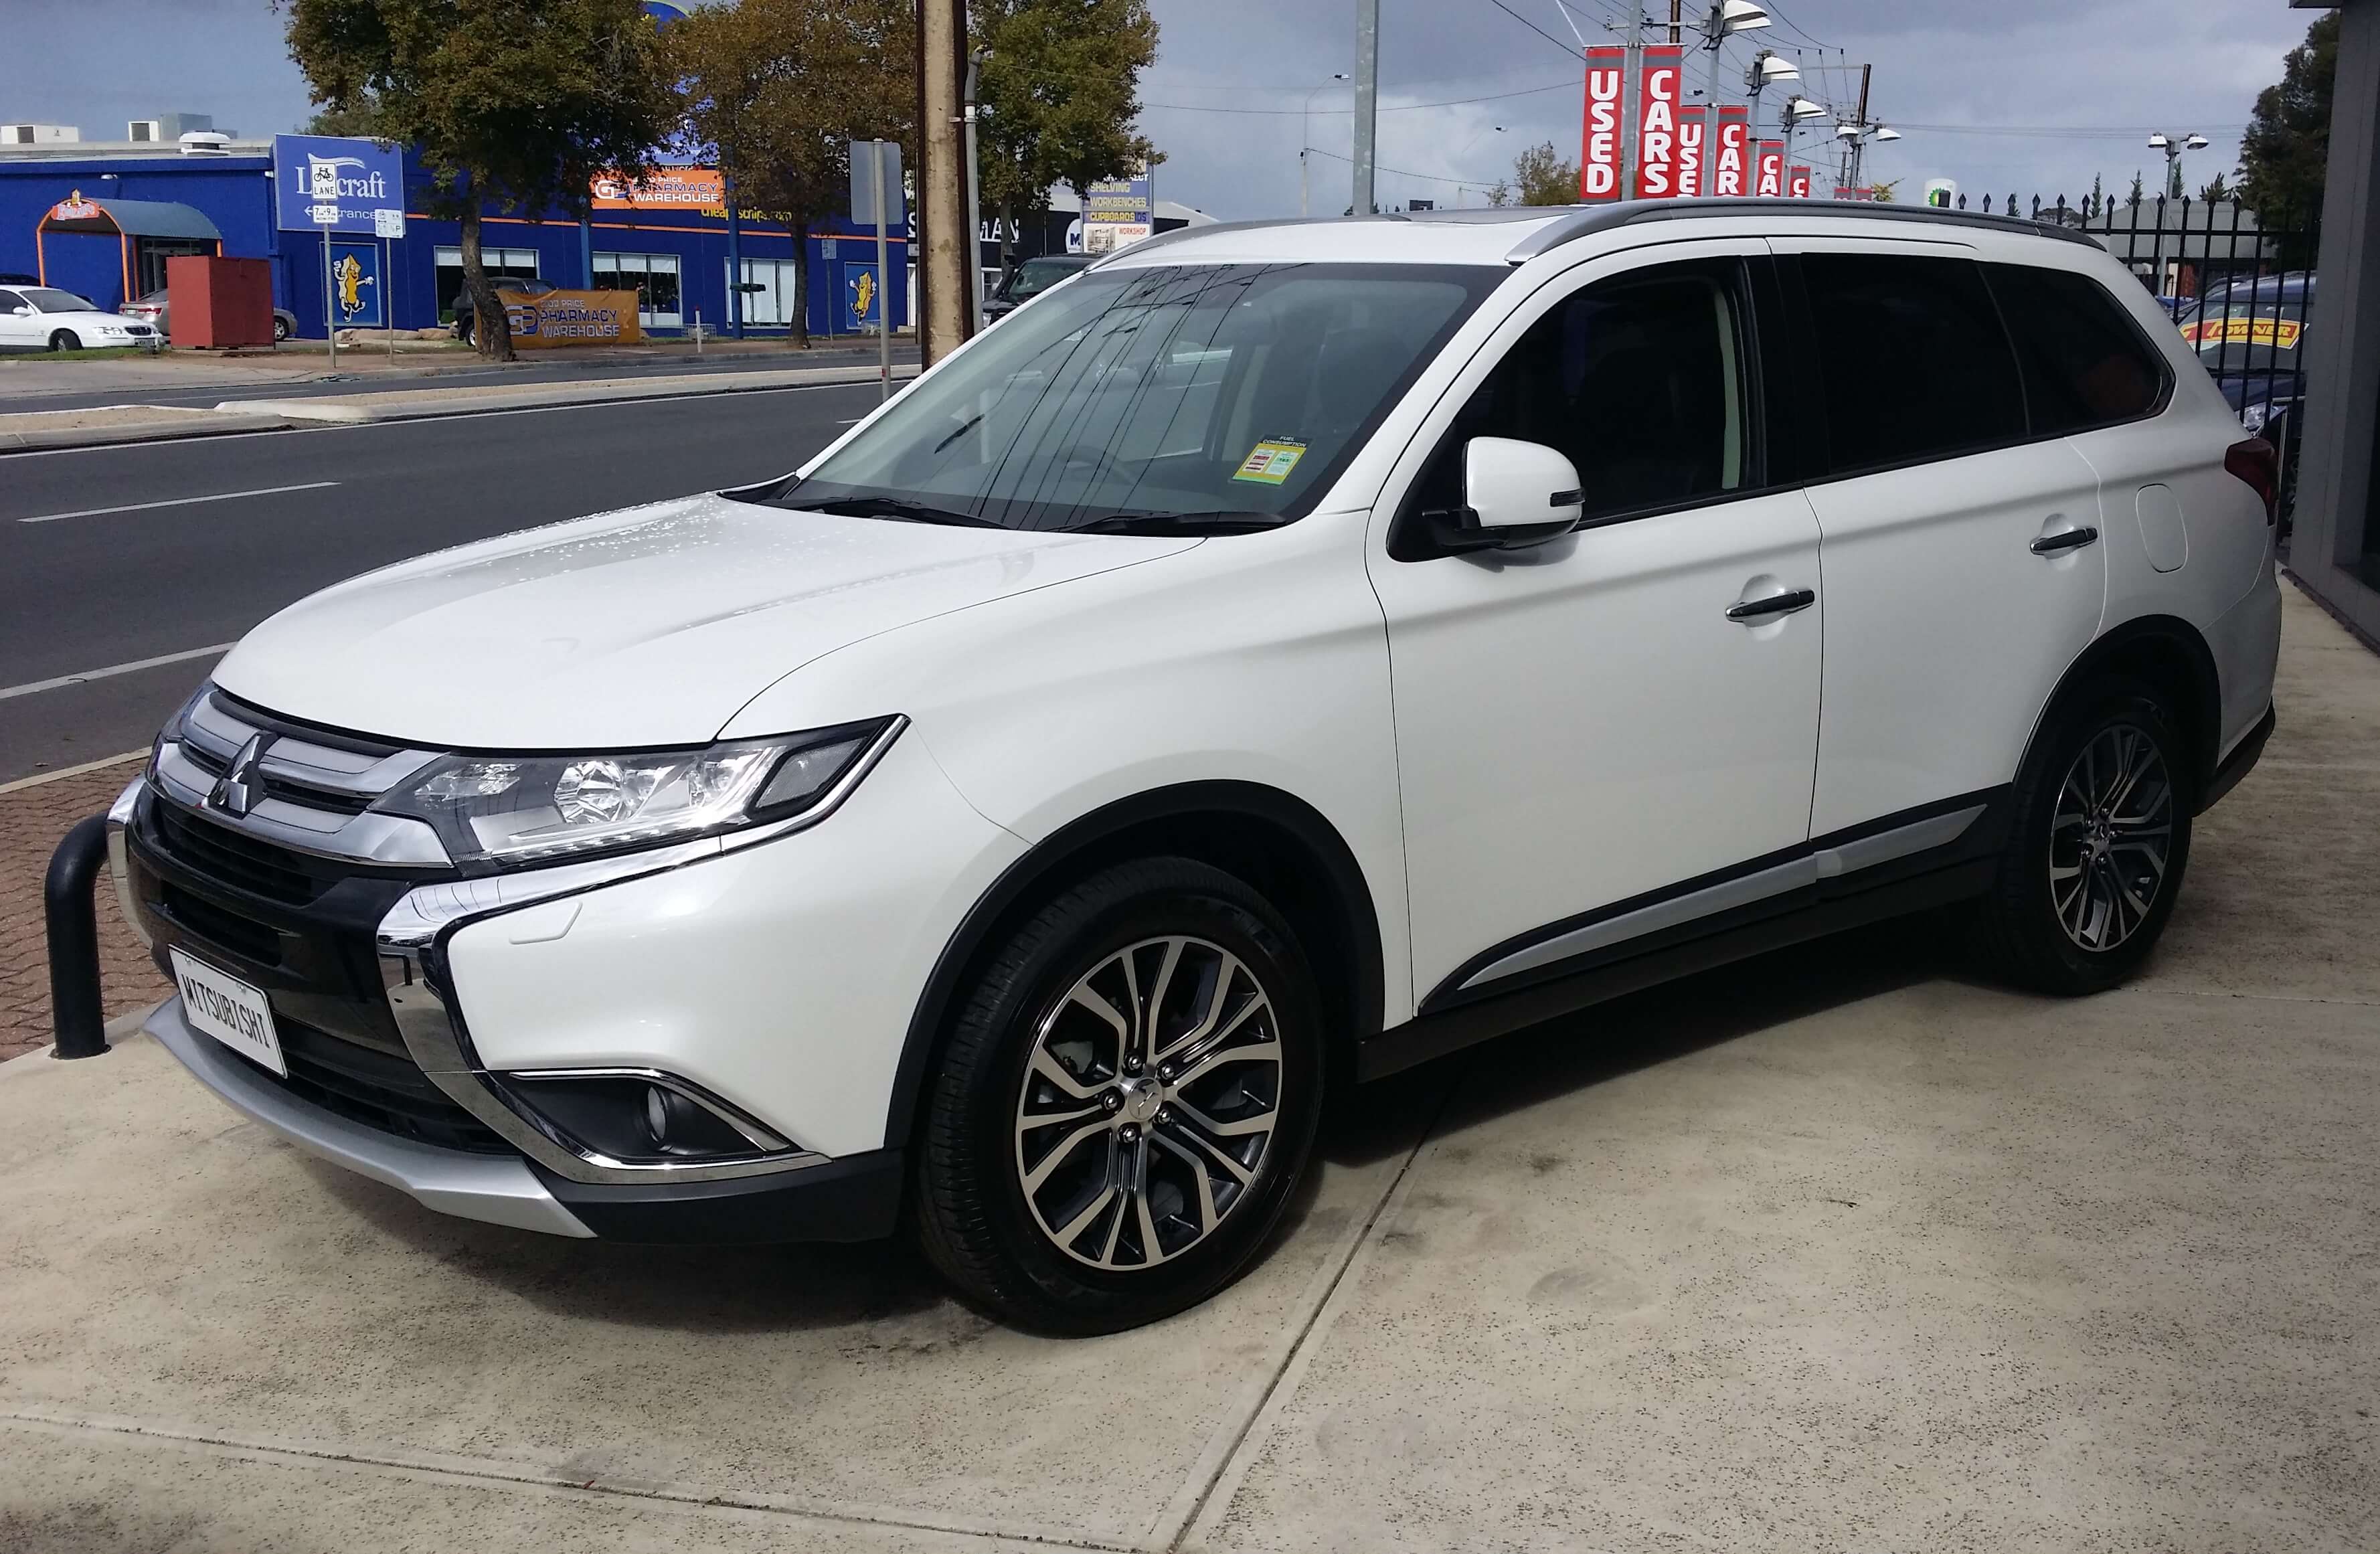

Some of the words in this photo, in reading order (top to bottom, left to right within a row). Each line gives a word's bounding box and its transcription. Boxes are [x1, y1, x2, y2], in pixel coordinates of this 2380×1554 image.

[1586, 70, 1618, 193] USED
[1644, 70, 1673, 193] CARS
[1678, 124, 1701, 197] USE
[1717, 124, 1741, 196] CAR
[295, 166, 386, 198] Lcraft
[1090, 182, 1130, 193] SHELVING
[314, 186, 335, 195] LANE
[634, 193, 719, 202] WAREHOUSE
[1090, 197, 1146, 207] WORKBENCHES
[1090, 212, 1136, 222] CUPBOARDS
[541, 309, 617, 323] PHARMACY
[543, 325, 620, 338] WAREHOUSE
[2217, 325, 2292, 337] OWNER
[1263, 439, 1307, 447] CONSUMPTION
[181, 974, 270, 1049] MITSUBISHI
